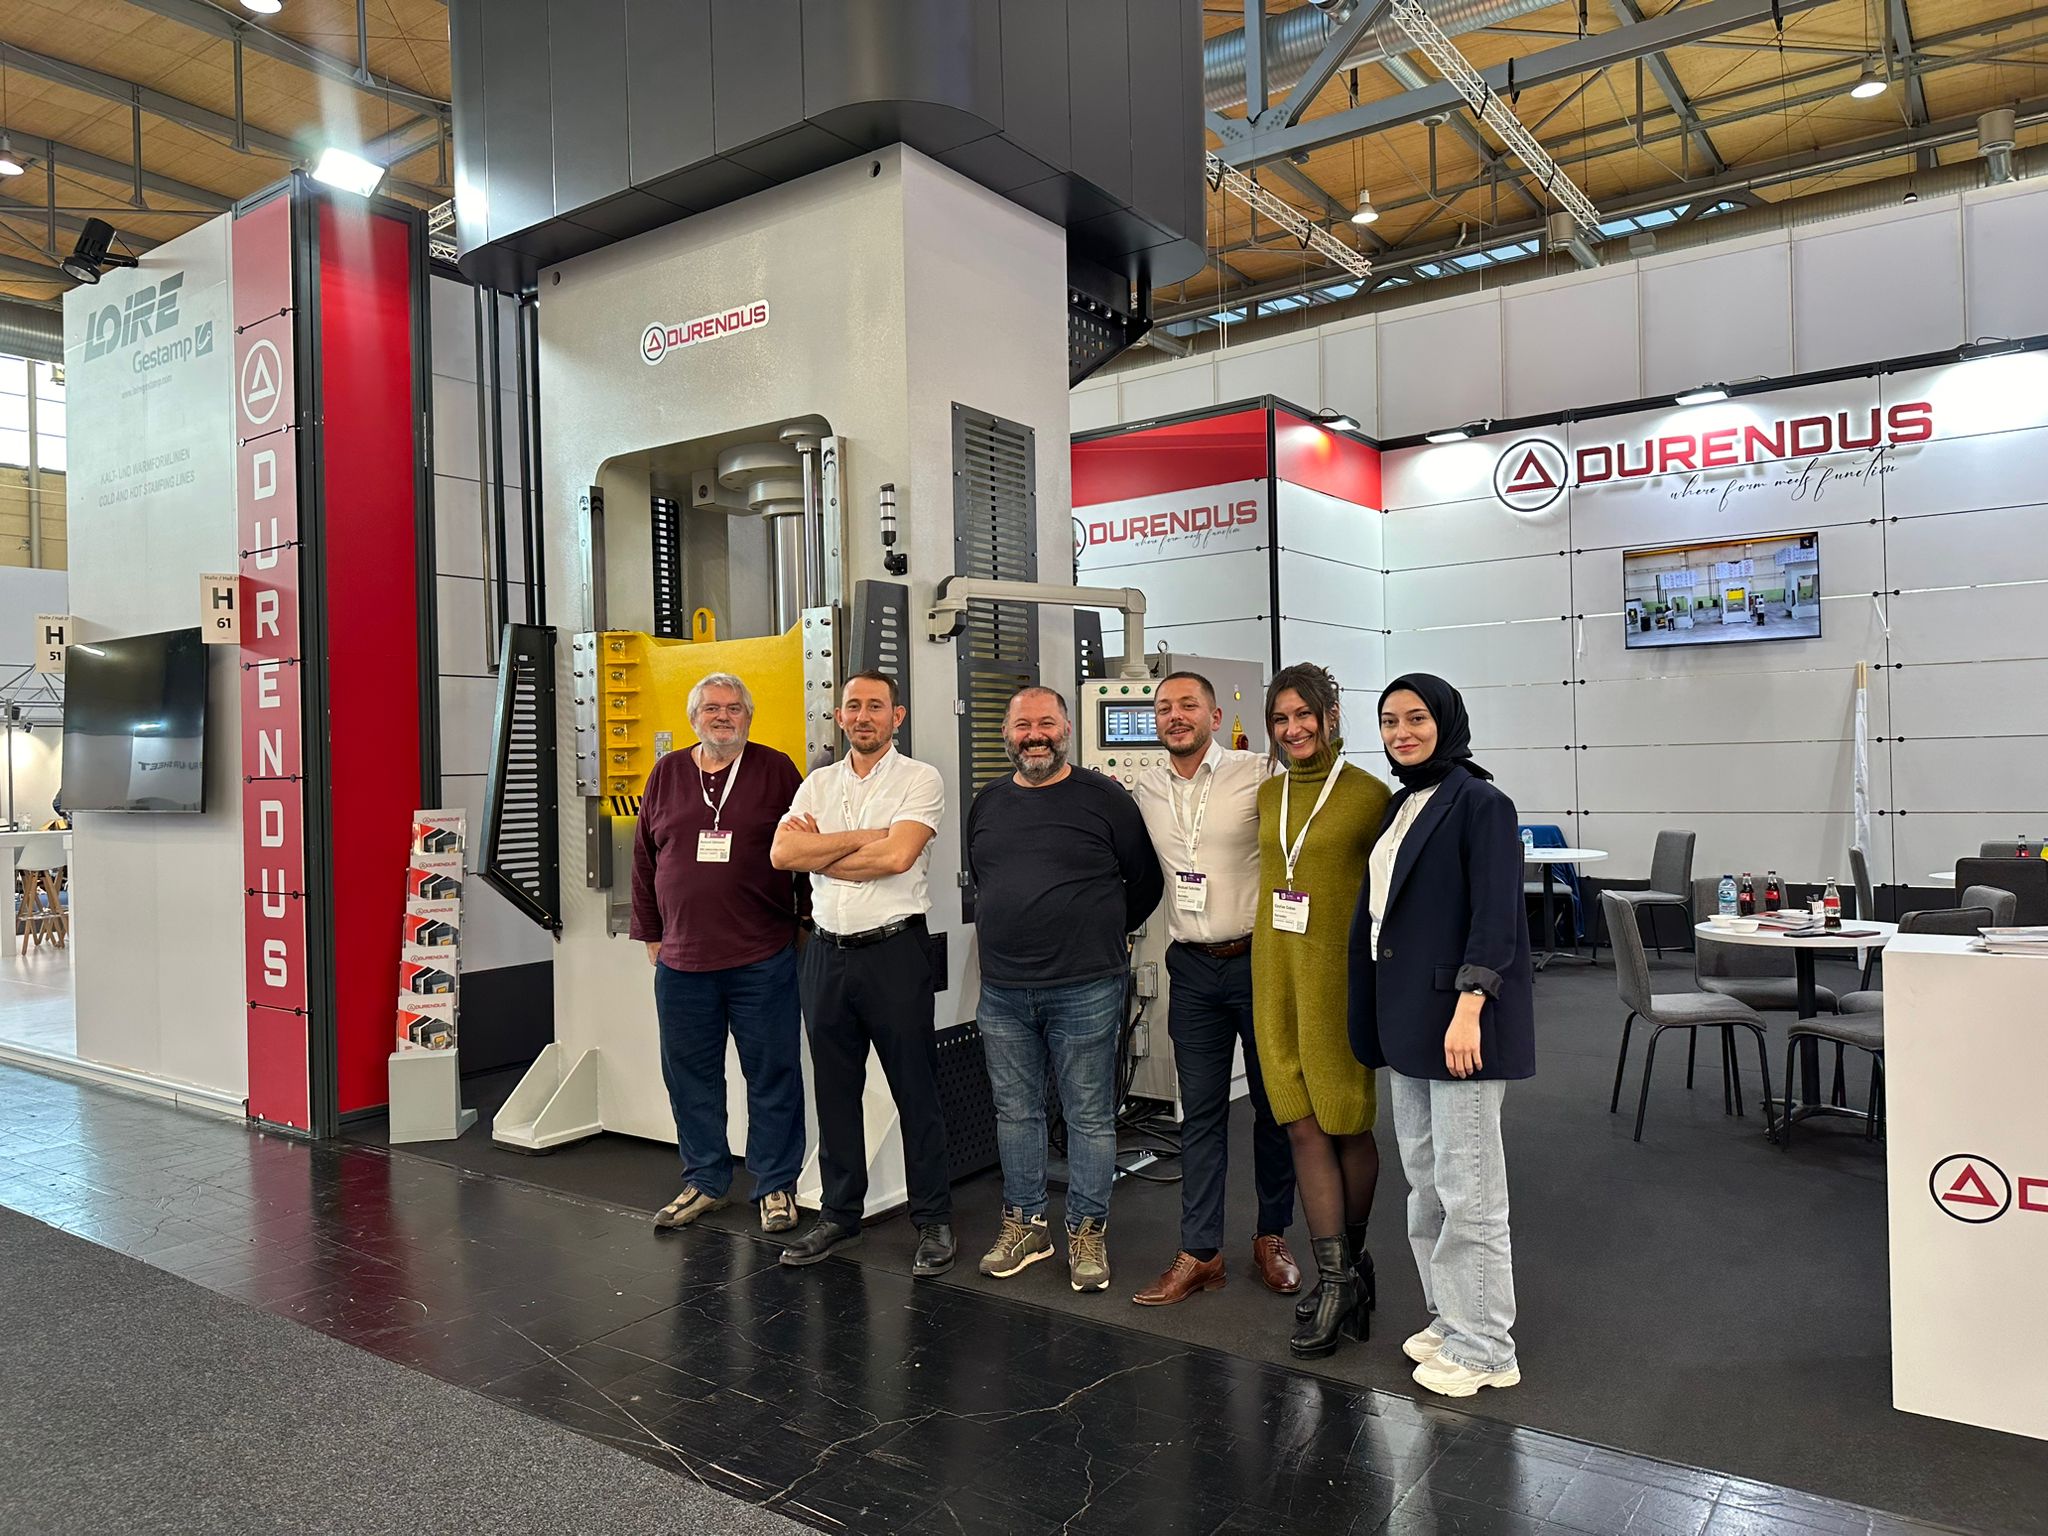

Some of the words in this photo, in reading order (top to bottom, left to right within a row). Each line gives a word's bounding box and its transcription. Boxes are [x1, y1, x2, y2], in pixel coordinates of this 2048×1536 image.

[84, 271, 184, 363] LOIRE
[667, 305, 766, 347] DURENDUS
[133, 337, 192, 373] Gestamp
[1576, 402, 1933, 484] DURENDUS
[1670, 474, 1718, 501] where
[1718, 479, 1767, 513] form
[1089, 500, 1257, 546] DURENDUS
[212, 587, 233, 610] H
[46, 626, 64, 645] H
[217, 617, 231, 629] 61
[50, 651, 61, 661] 51
